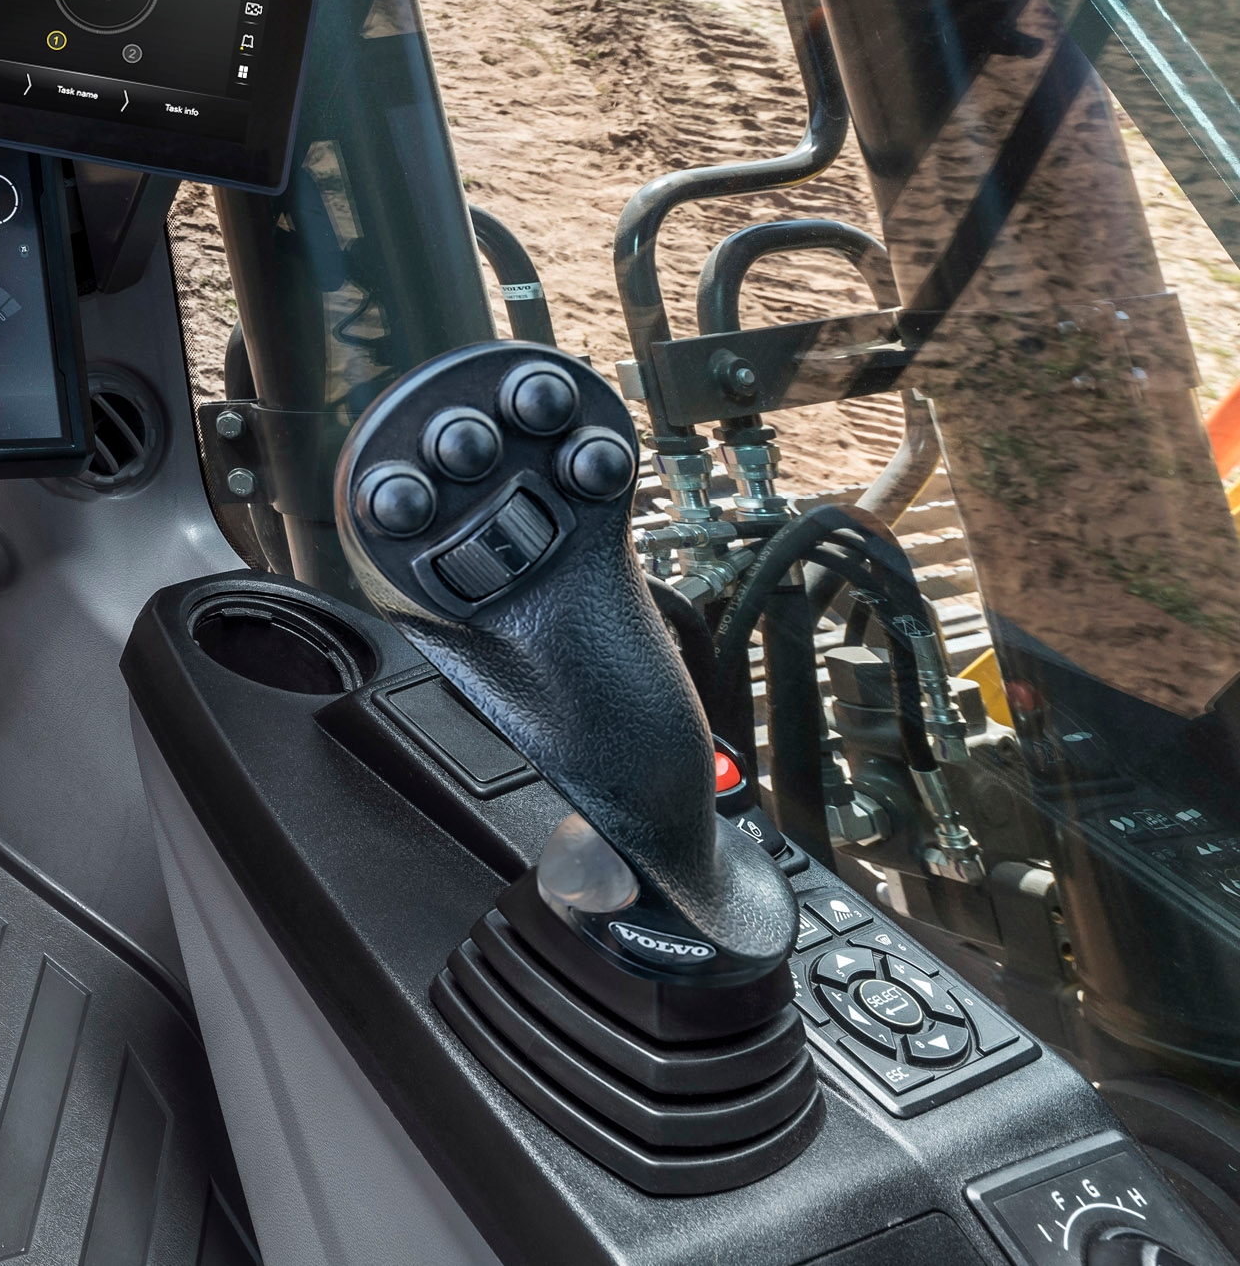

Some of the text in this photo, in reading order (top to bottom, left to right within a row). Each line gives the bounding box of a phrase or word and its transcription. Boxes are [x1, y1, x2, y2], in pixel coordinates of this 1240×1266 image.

[57, 85, 98, 100] Task name
[165, 103, 199, 116] Task info
[719, 614, 732, 635] ISO
[748, 562, 761, 578] EN
[853, 910, 862, 918] 3
[615, 924, 709, 956] VOLVO
[867, 987, 903, 1009] SELECT
[885, 1066, 909, 1083] ESC
[1051, 1190, 1065, 1211] F
[1082, 1179, 1101, 1197] G
[1127, 1187, 1148, 1207] H
